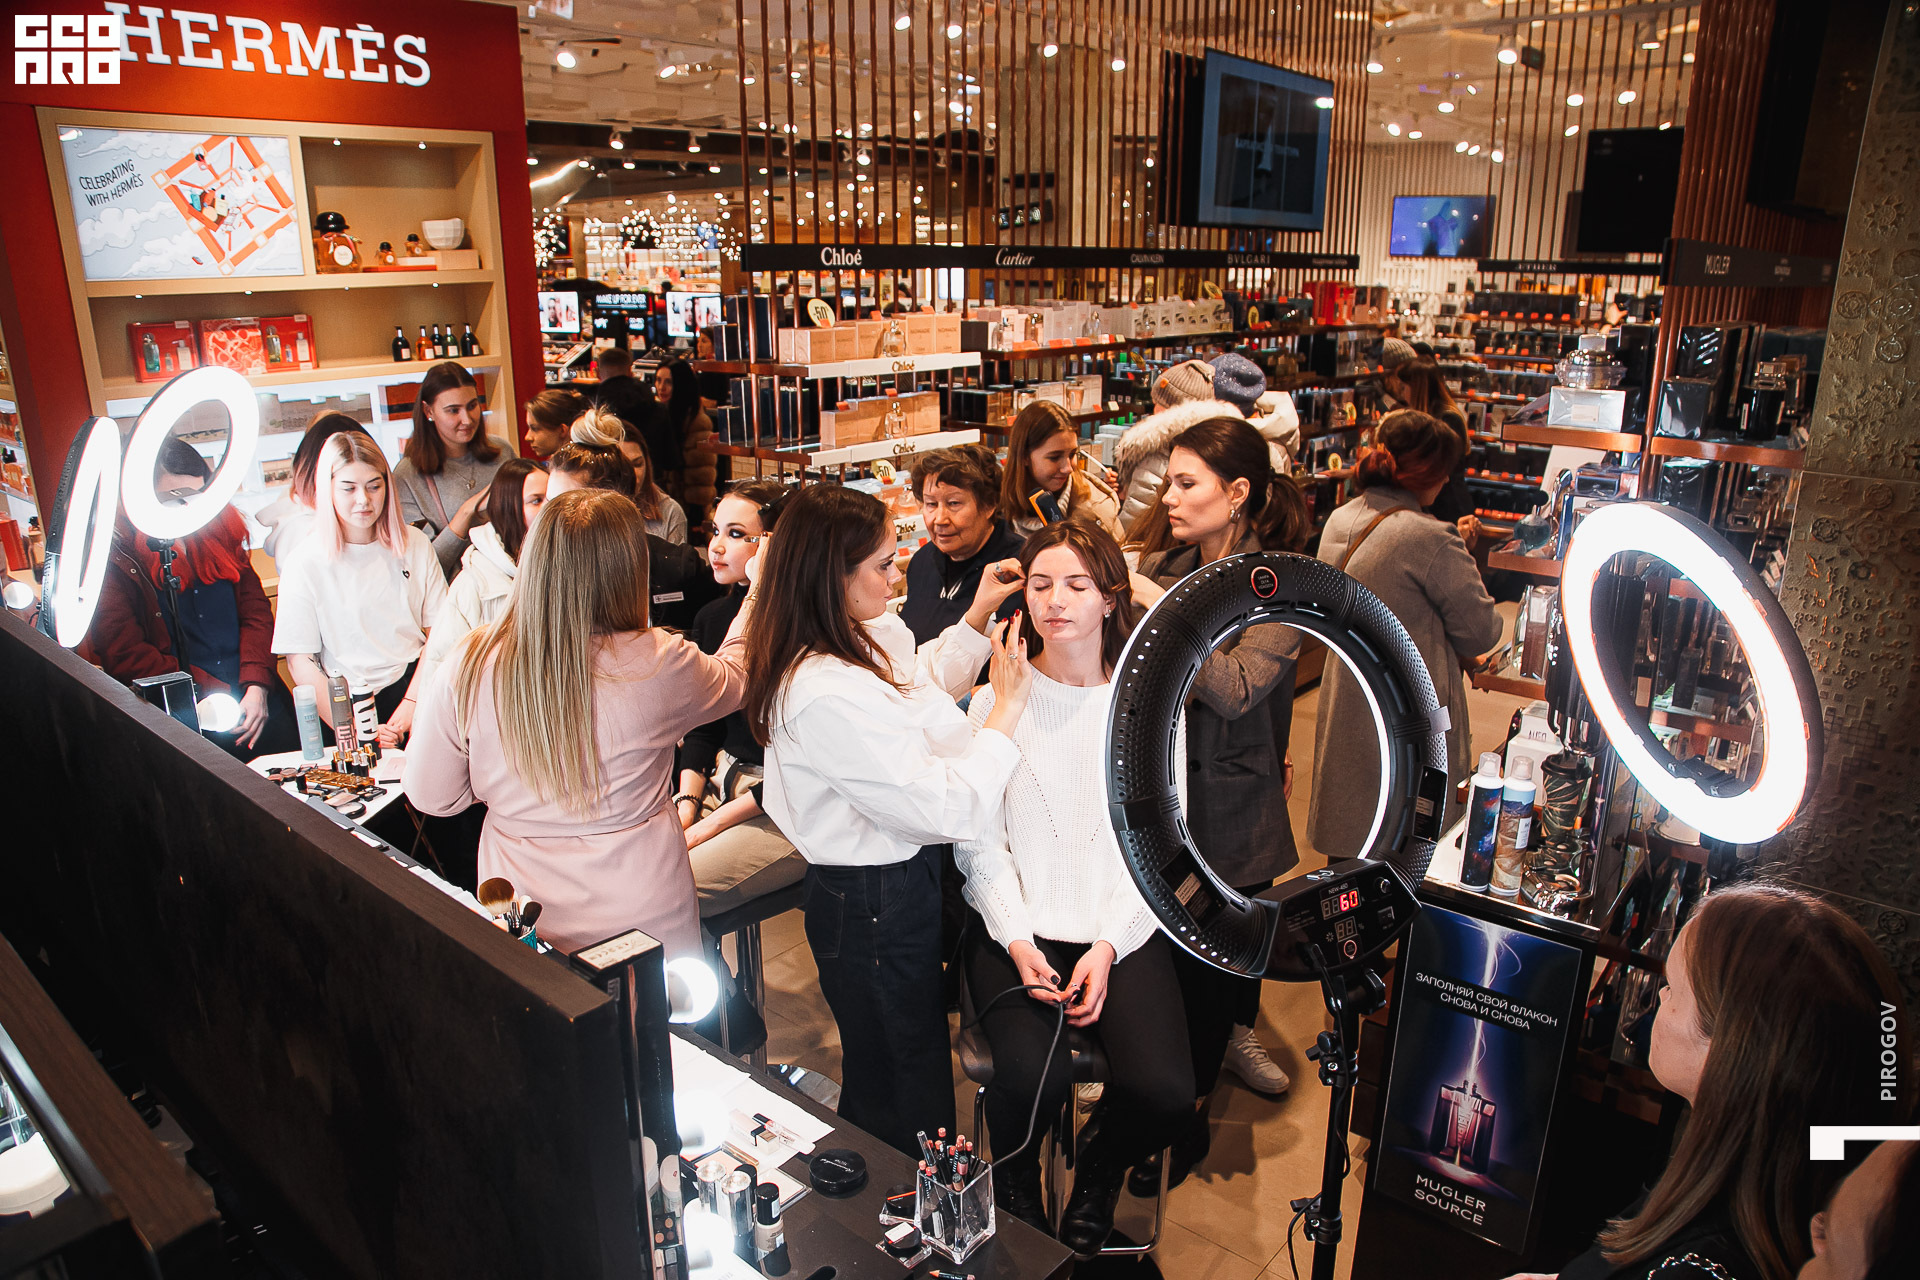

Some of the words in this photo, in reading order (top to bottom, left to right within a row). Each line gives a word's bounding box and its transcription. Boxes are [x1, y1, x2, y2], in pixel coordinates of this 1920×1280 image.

[104, 1, 431, 87] HERMÈS
[79, 158, 135, 190] CELEBRATING
[85, 191, 110, 207] WITH
[110, 172, 144, 200] HERMÈS
[820, 246, 863, 266] Chloé
[995, 247, 1035, 266] Cartier
[1227, 253, 1271, 265] BVLGARI
[891, 360, 916, 373] Chloé
[1415, 972, 1474, 999] ЗАПОЛНЯЙ
[1476, 992, 1508, 1010] СВОЙ
[1510, 1004, 1558, 1027] ФЛАКОН
[1440, 992, 1478, 1012] СНОВА
[1480, 1005, 1489, 1016] И
[1491, 1009, 1530, 1030] СНОВА
[1414, 1189, 1484, 1226] SOURCE
[1416, 1174, 1486, 1212] MUGLER
